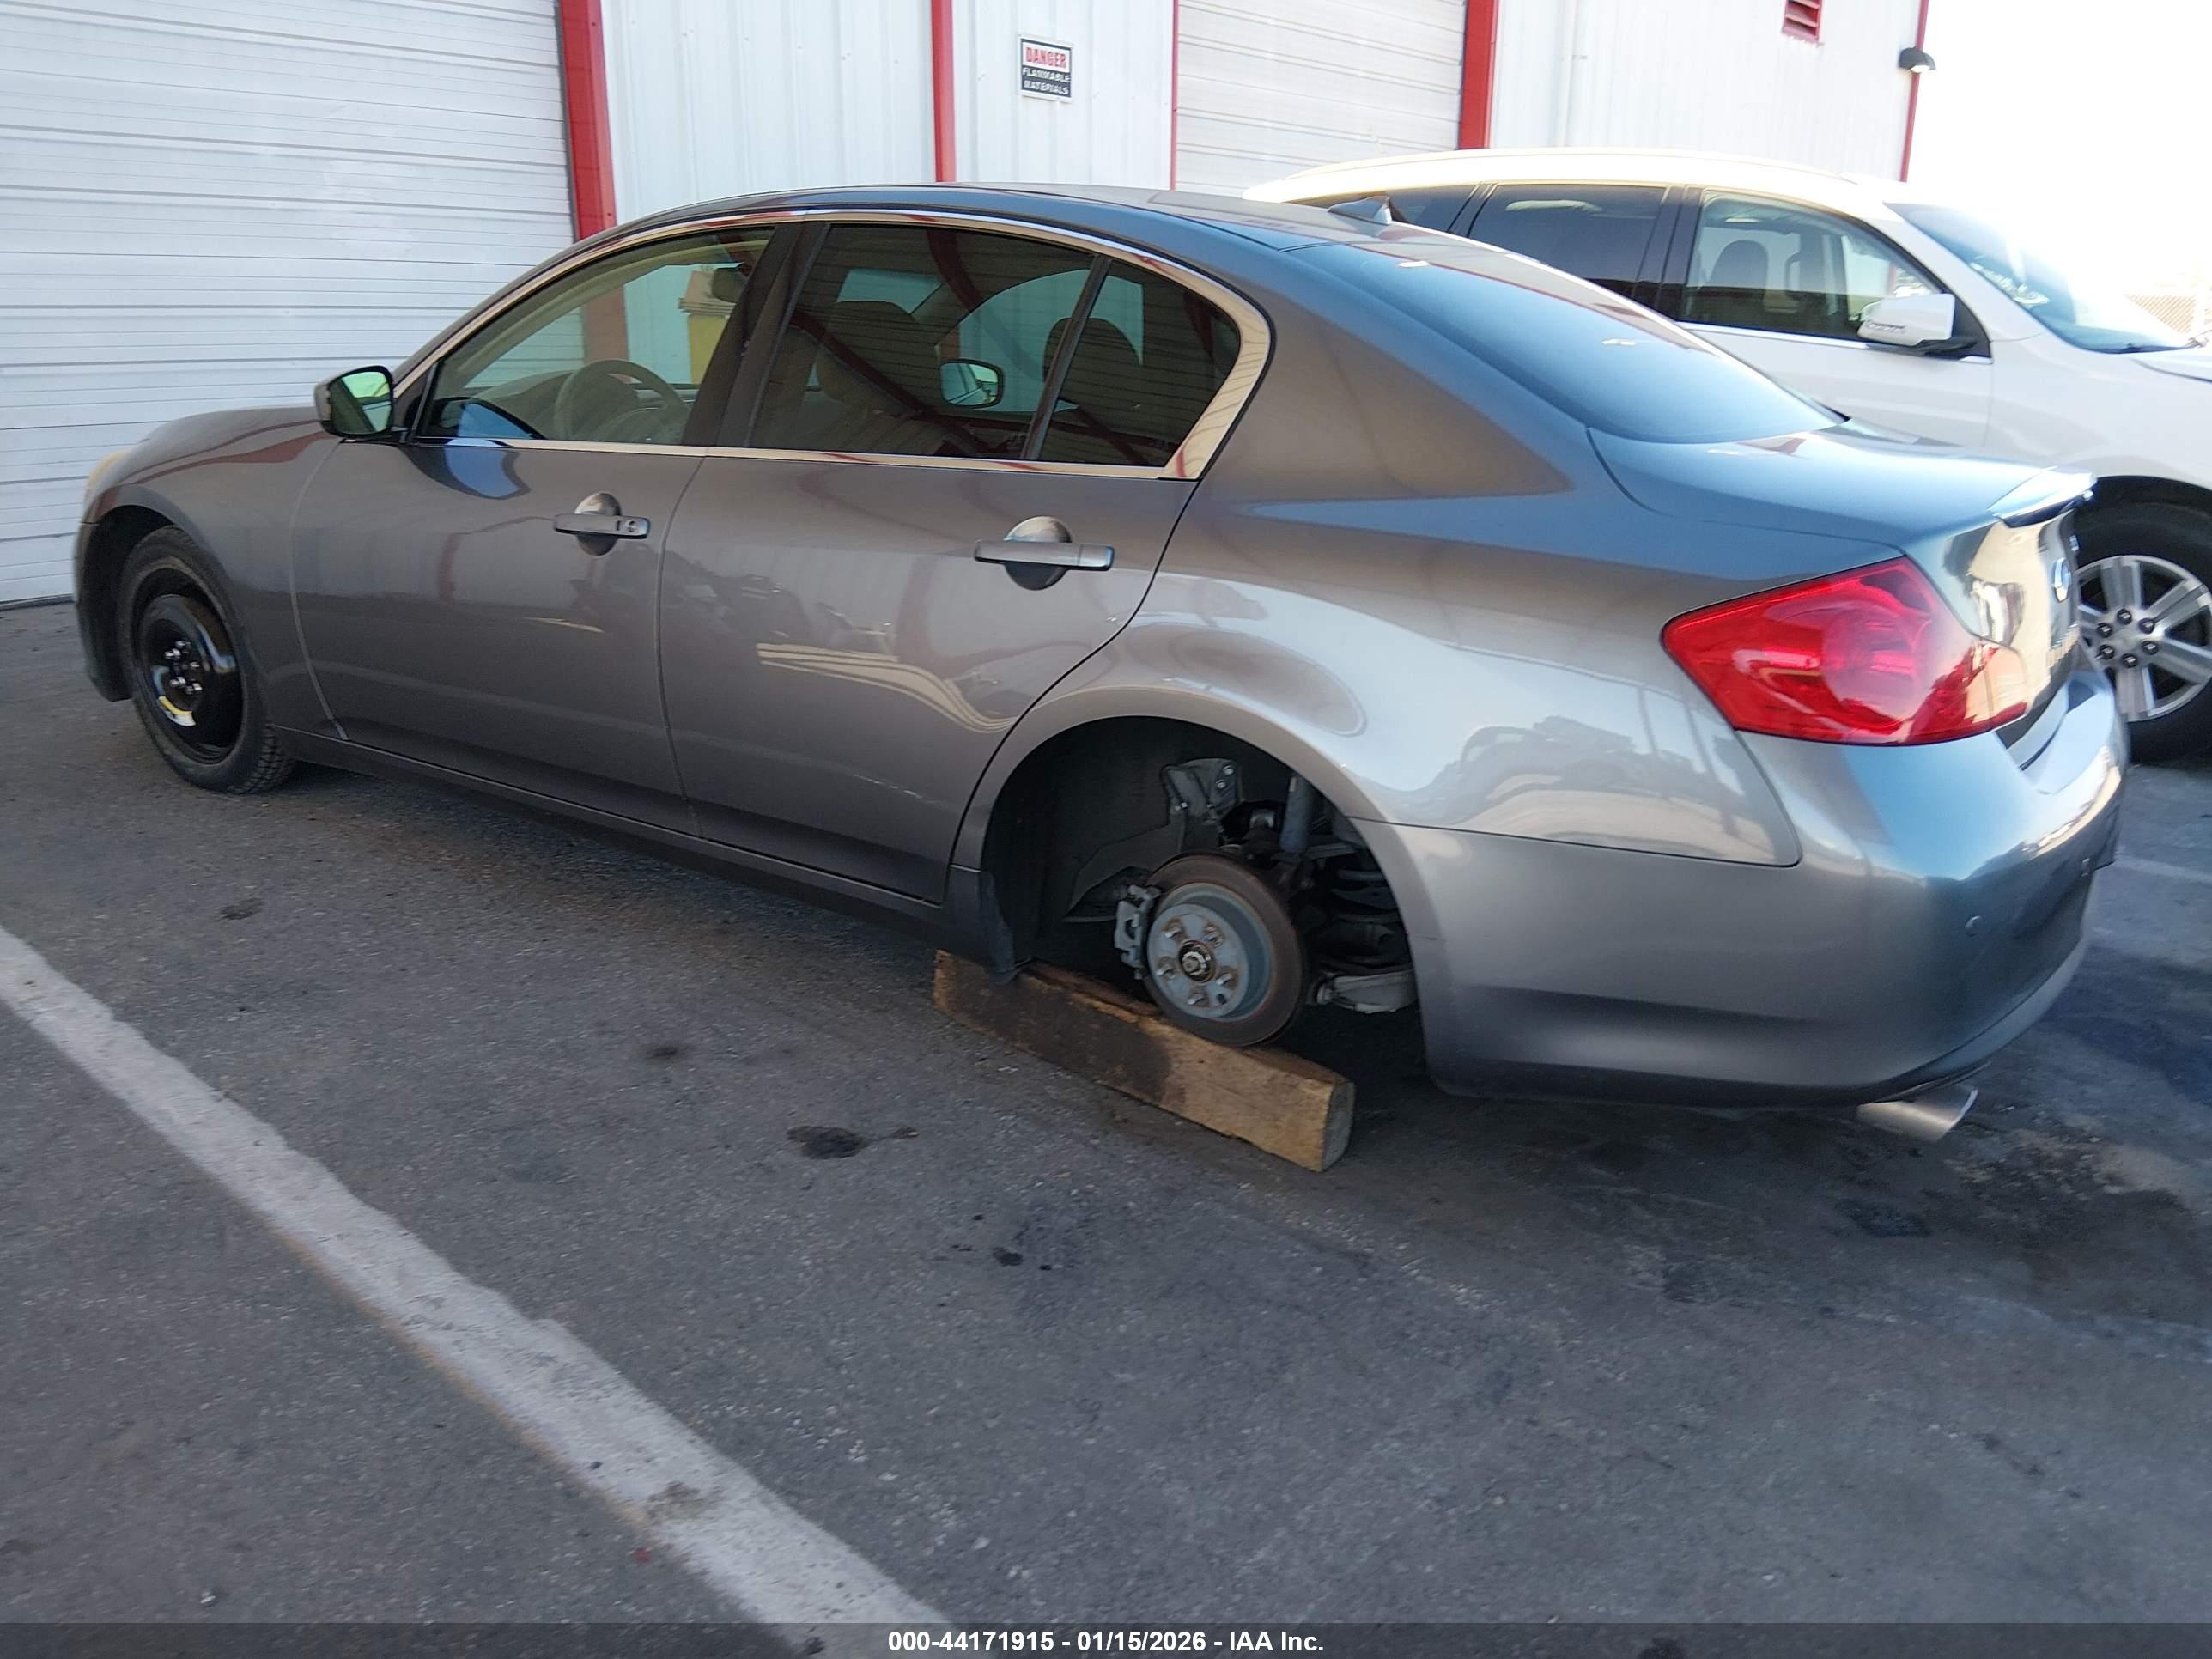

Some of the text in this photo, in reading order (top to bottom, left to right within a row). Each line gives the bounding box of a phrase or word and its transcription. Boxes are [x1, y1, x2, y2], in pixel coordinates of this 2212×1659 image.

[1025, 46, 1066, 68] DANGER
[1022, 67, 1071, 82] FLAMMABLE
[1023, 80, 1069, 94] MATERIALS
